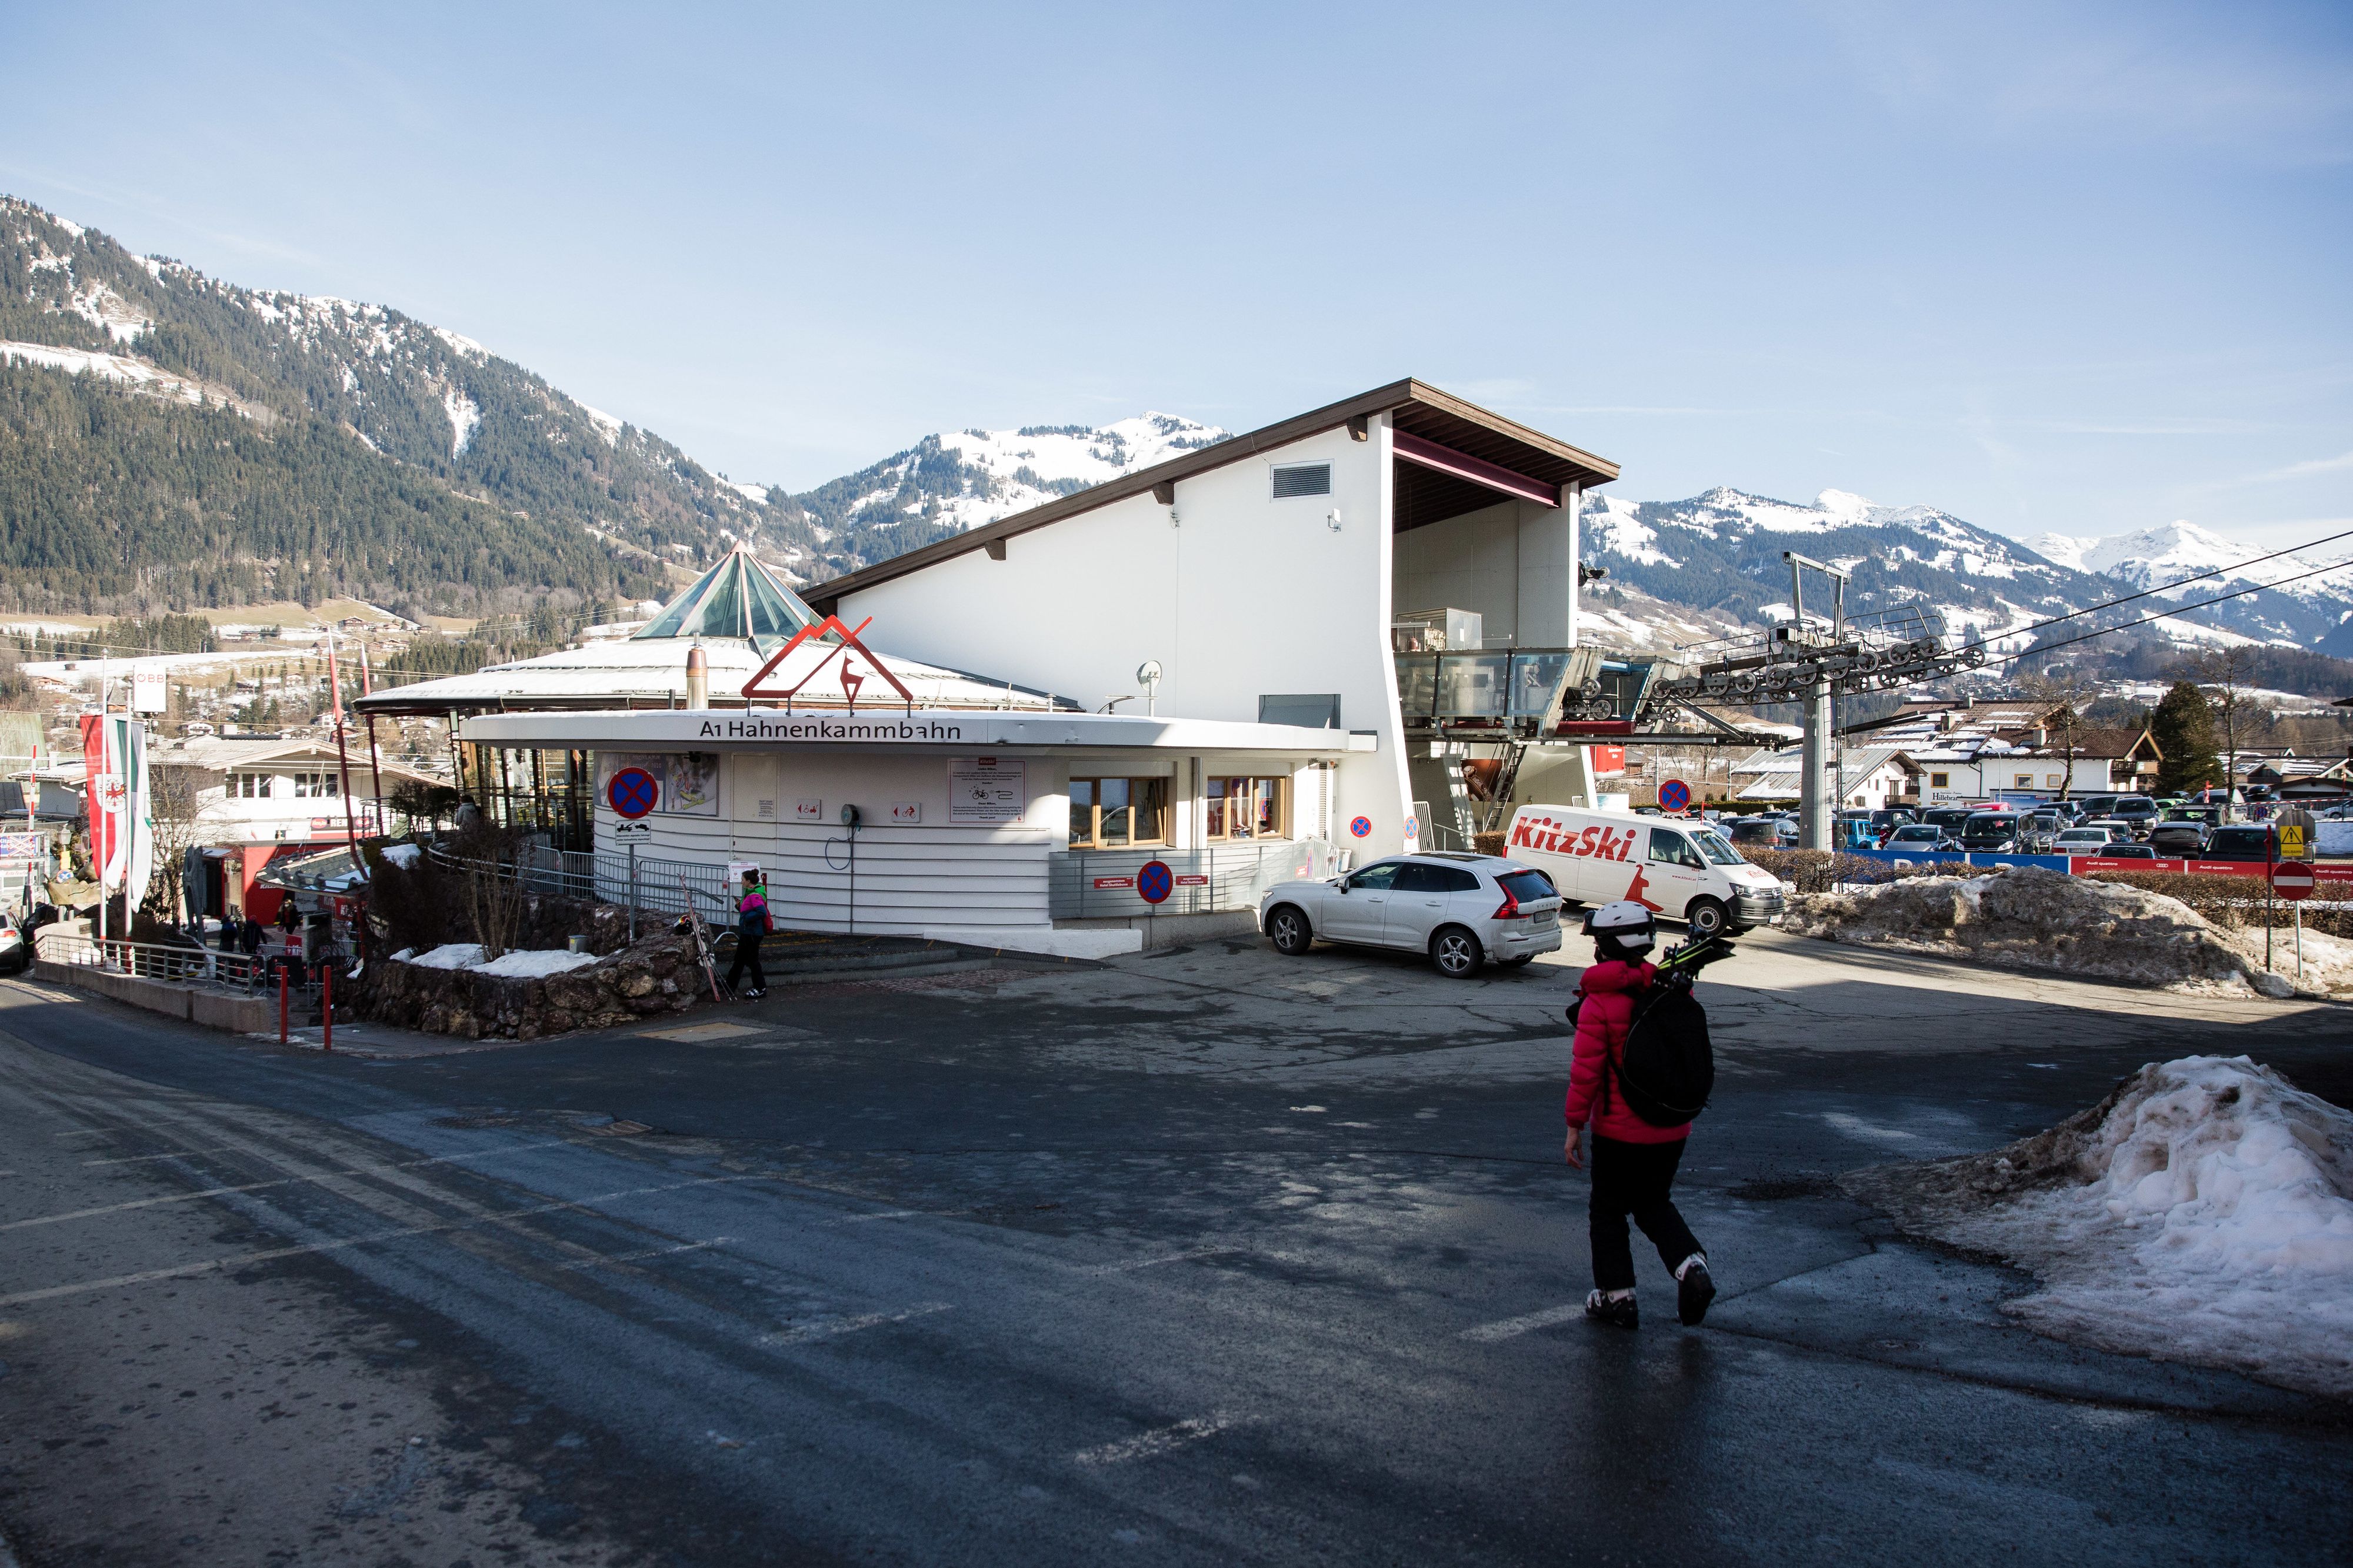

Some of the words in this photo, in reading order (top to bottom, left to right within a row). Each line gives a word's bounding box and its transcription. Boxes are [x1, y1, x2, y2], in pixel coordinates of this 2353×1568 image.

[699, 720, 721, 737] A1
[728, 720, 961, 739] Hahnenkammbahn
[1932, 792, 1958, 801] Hillebra
[1510, 816, 1637, 862] KitzSki
